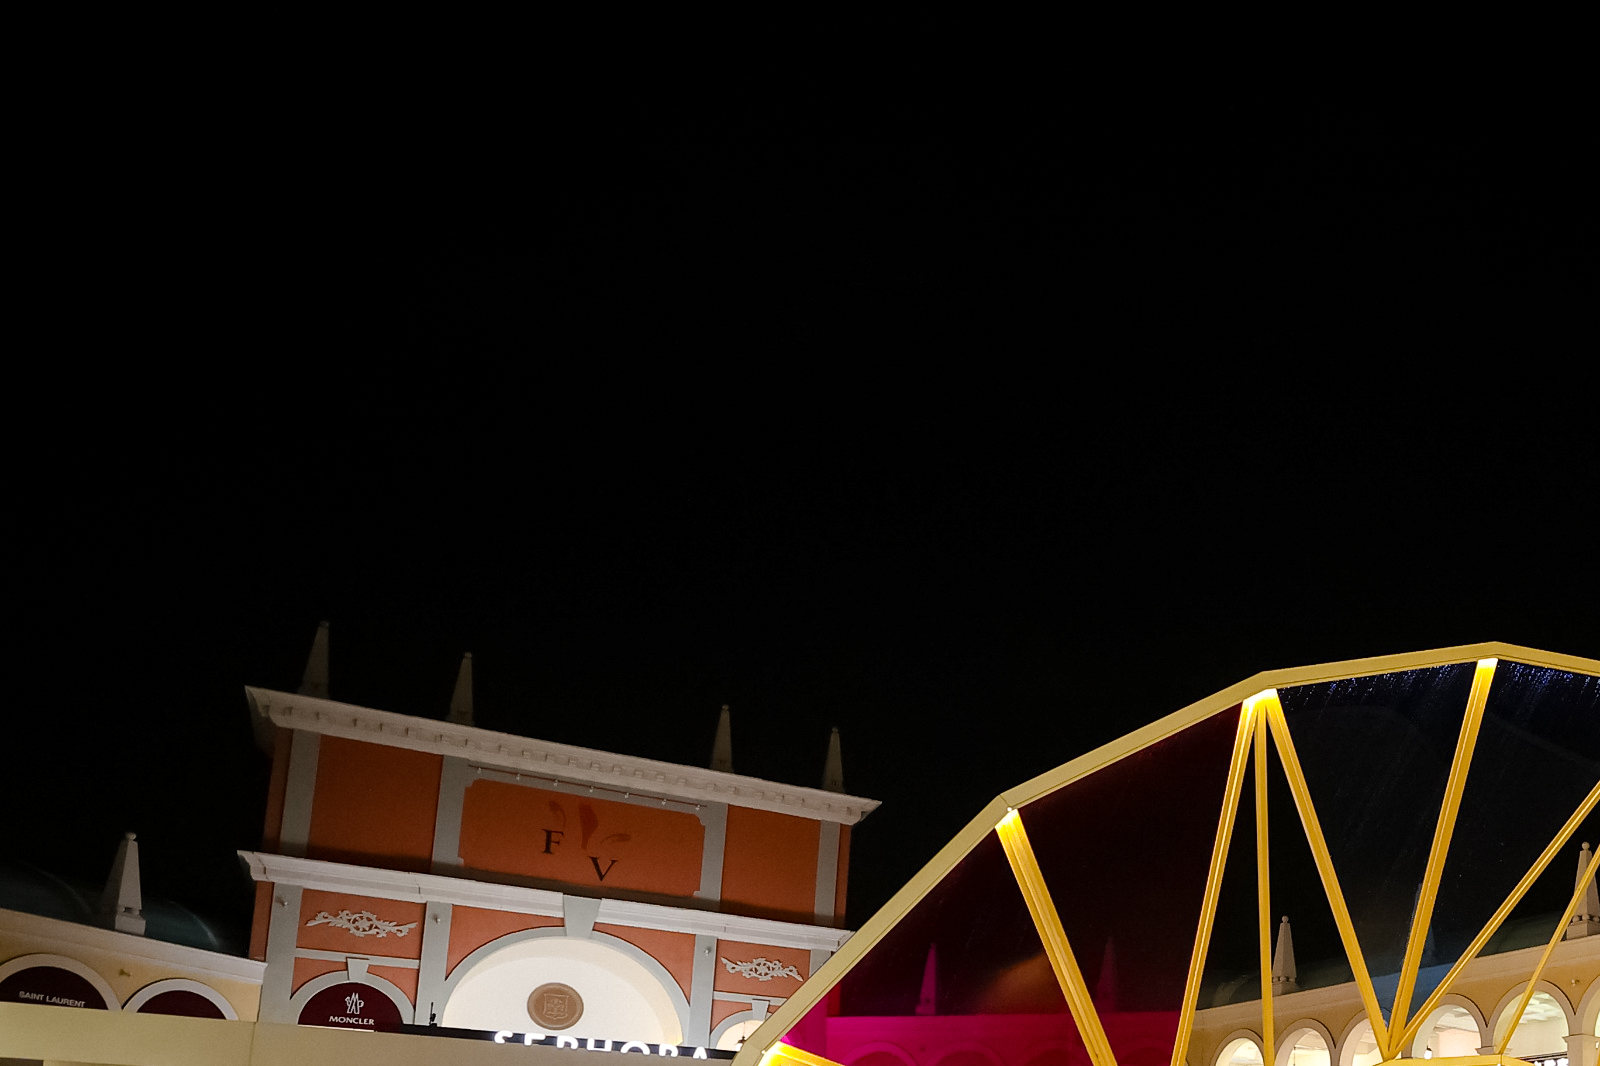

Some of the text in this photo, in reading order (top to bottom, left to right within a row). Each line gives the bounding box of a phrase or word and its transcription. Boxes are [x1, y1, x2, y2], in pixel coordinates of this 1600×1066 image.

[541, 828, 565, 854] F
[587, 856, 619, 882] V
[19, 990, 86, 1008] SAINT LAURENT
[328, 1015, 375, 1026] MONCLER
